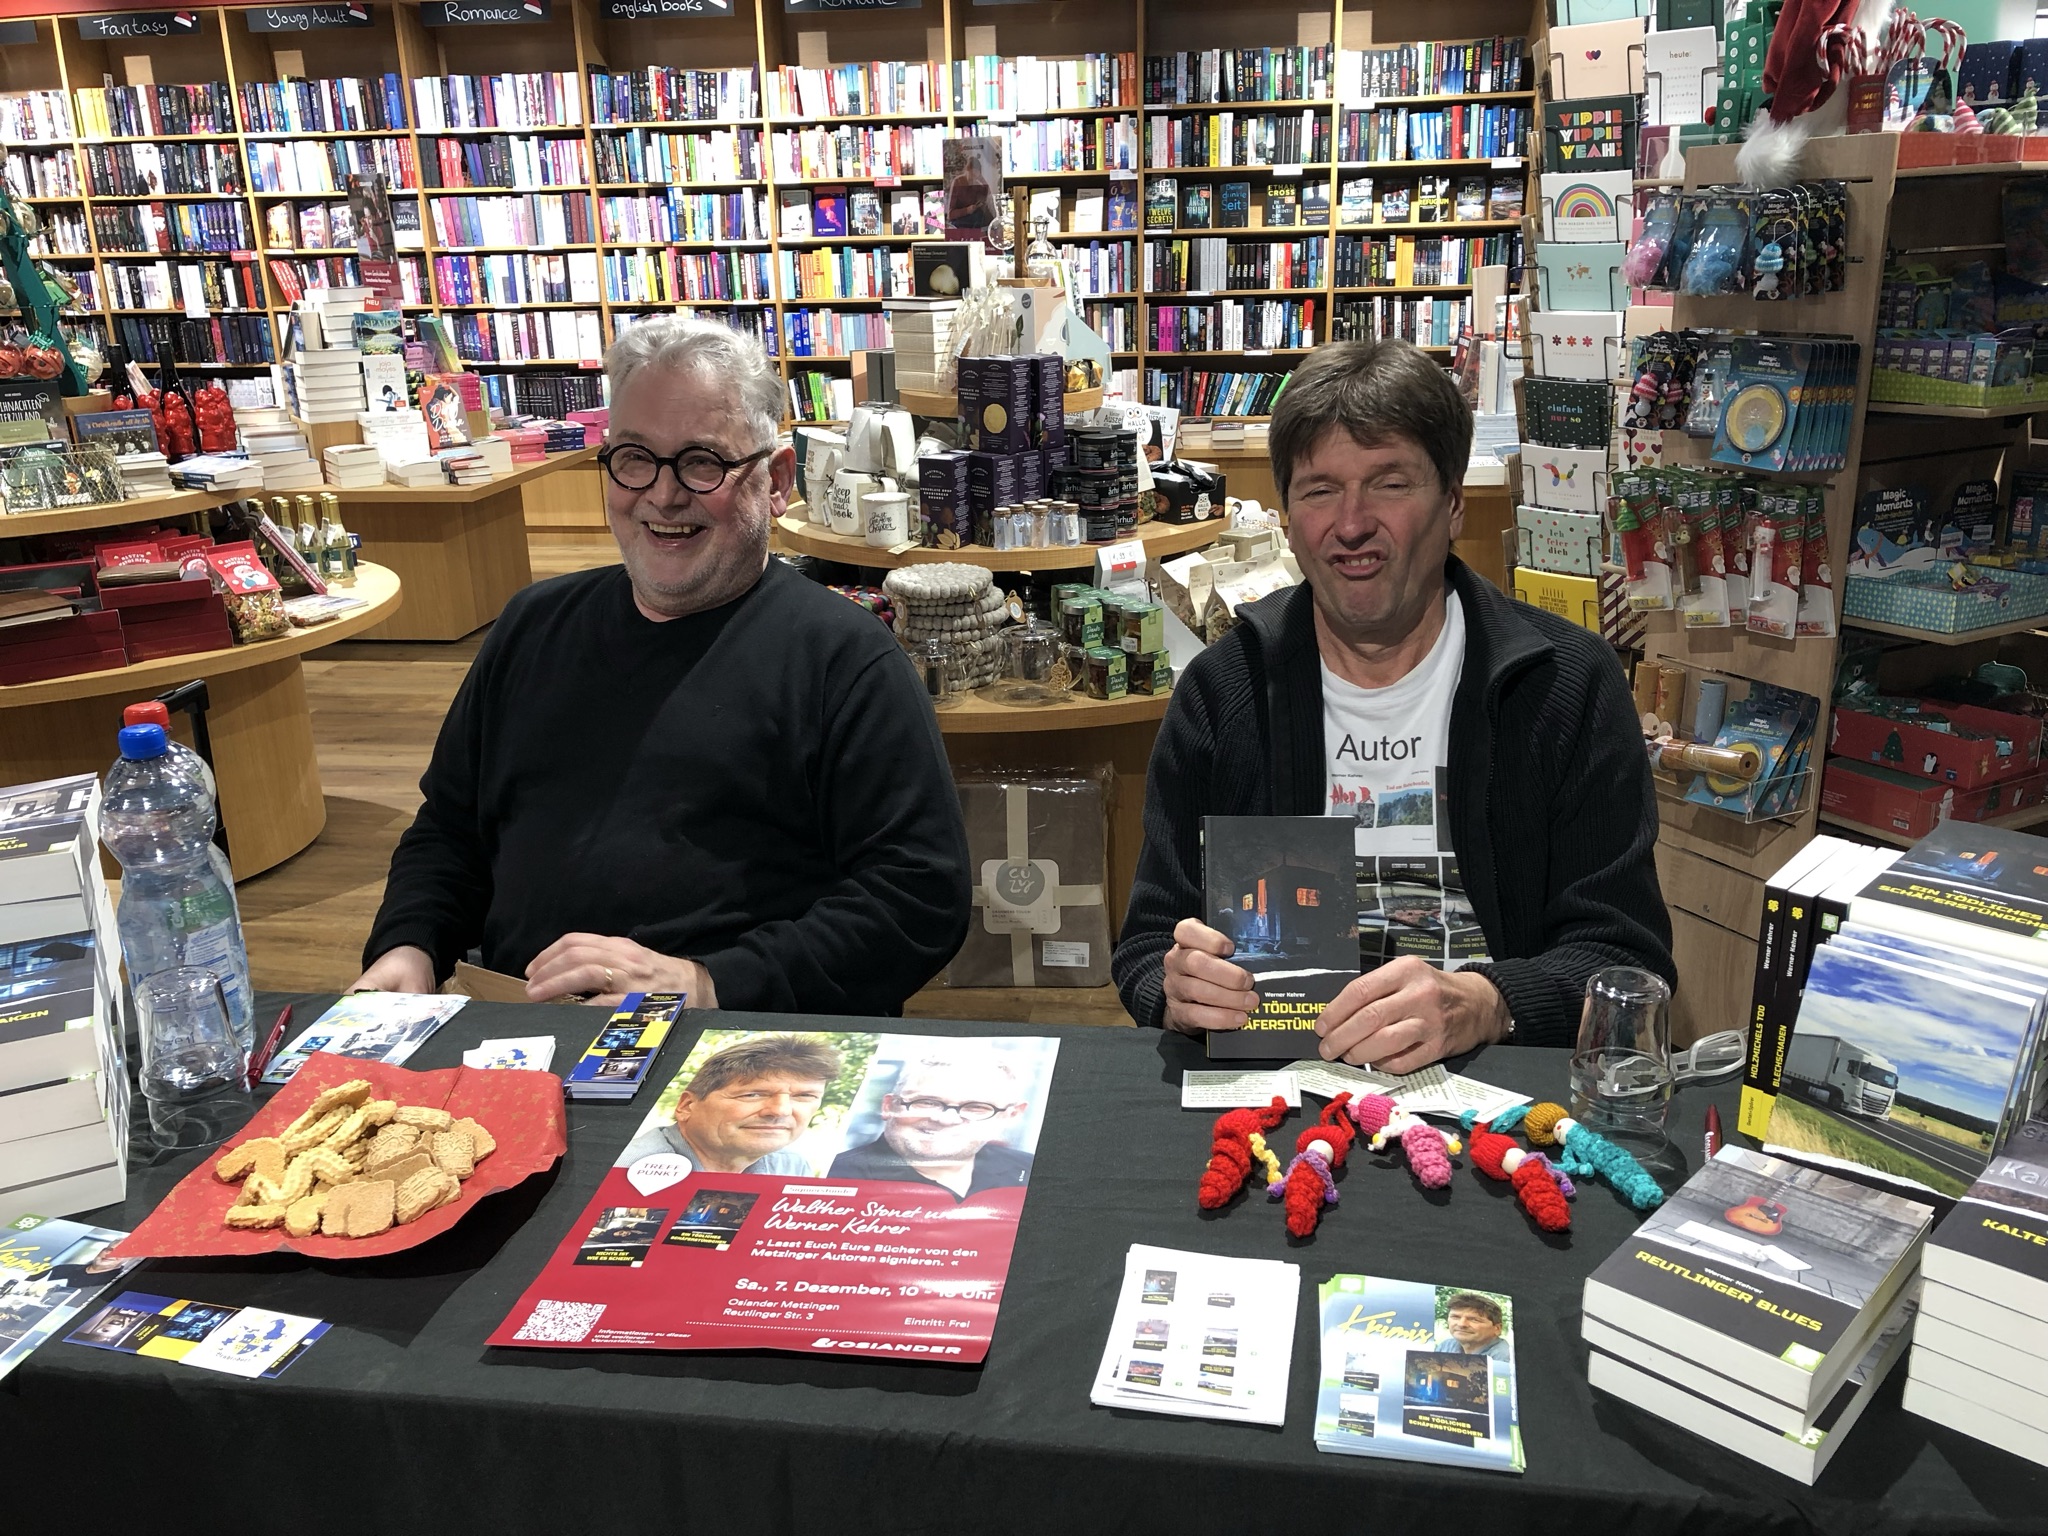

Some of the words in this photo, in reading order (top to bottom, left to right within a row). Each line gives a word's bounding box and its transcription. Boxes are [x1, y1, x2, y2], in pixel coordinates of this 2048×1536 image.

[265, 8, 310, 31] Young
[312, 9, 348, 24] Adult
[445, 1, 521, 22] Romance
[93, 16, 169, 36] Fantasy
[1559, 109, 1623, 126] YIPPIE
[1560, 126, 1623, 143] YIPPIE
[1560, 142, 1623, 160] YEAH!
[1147, 215, 1173, 223] SECRETS
[1148, 208, 1172, 216] TWELVE
[1547, 404, 1583, 414] einfach
[1570, 416, 1581, 424] so
[1618, 481, 1650, 497] PEZ
[1883, 489, 1907, 501] Magic
[1966, 483, 1988, 494] Magic
[1678, 490, 1711, 507] PEZ
[1761, 496, 1800, 514] PEZ
[1876, 499, 1914, 513] Moments
[1957, 492, 1993, 505] Moments
[1548, 546, 1568, 557] dich
[1335, 733, 1422, 761] Autor
[1909, 884, 1940, 896] EIN
[1945, 893, 2043, 921] TÖDLICHES
[1790, 929, 1798, 950] Kehrer
[1763, 944, 1771, 969] Werner
[1786, 952, 1794, 977] Werner
[1756, 1005, 1765, 1021] TOD
[1750, 1023, 1763, 1079] HOLZMICHELS
[1772, 1025, 1787, 1088] BLECHSCHADEN
[643, 1163, 681, 1171] TREFF
[771, 1196, 855, 1217] Walther
[860, 1201, 923, 1219] Stonet
[763, 1213, 840, 1232] Werner
[841, 1217, 911, 1236] Kehrer
[804, 1240, 837, 1250] Euch
[840, 1242, 871, 1252] Eure
[874, 1243, 922, 1255] Bücher
[925, 1249, 949, 1257] von
[952, 1247, 978, 1257] den
[751, 1248, 820, 1261] Metzinger
[821, 1252, 876, 1263] Autoren
[879, 1254, 945, 1267] signieren.
[735, 1278, 769, 1292] Sa.,
[775, 1280, 789, 1292] 7.
[793, 1281, 892, 1297] Dezember,
[898, 1286, 918, 1297] 10
[961, 1286, 996, 1301] Uhr
[1635, 1250, 1753, 1304] REUTLINGER
[1751, 1298, 1823, 1332] BLUES
[727, 1298, 779, 1309] Osiander
[780, 1300, 840, 1312] Metzingen
[722, 1308, 782, 1320] Reutlinger
[783, 1310, 802, 1320] Str.
[805, 1312, 815, 1321] 3
[904, 1317, 946, 1328] Eintritt:
[948, 1318, 971, 1329] Frei
[1338, 1304, 1434, 1344] Krimis
[837, 1339, 962, 1355] OSIANDER
